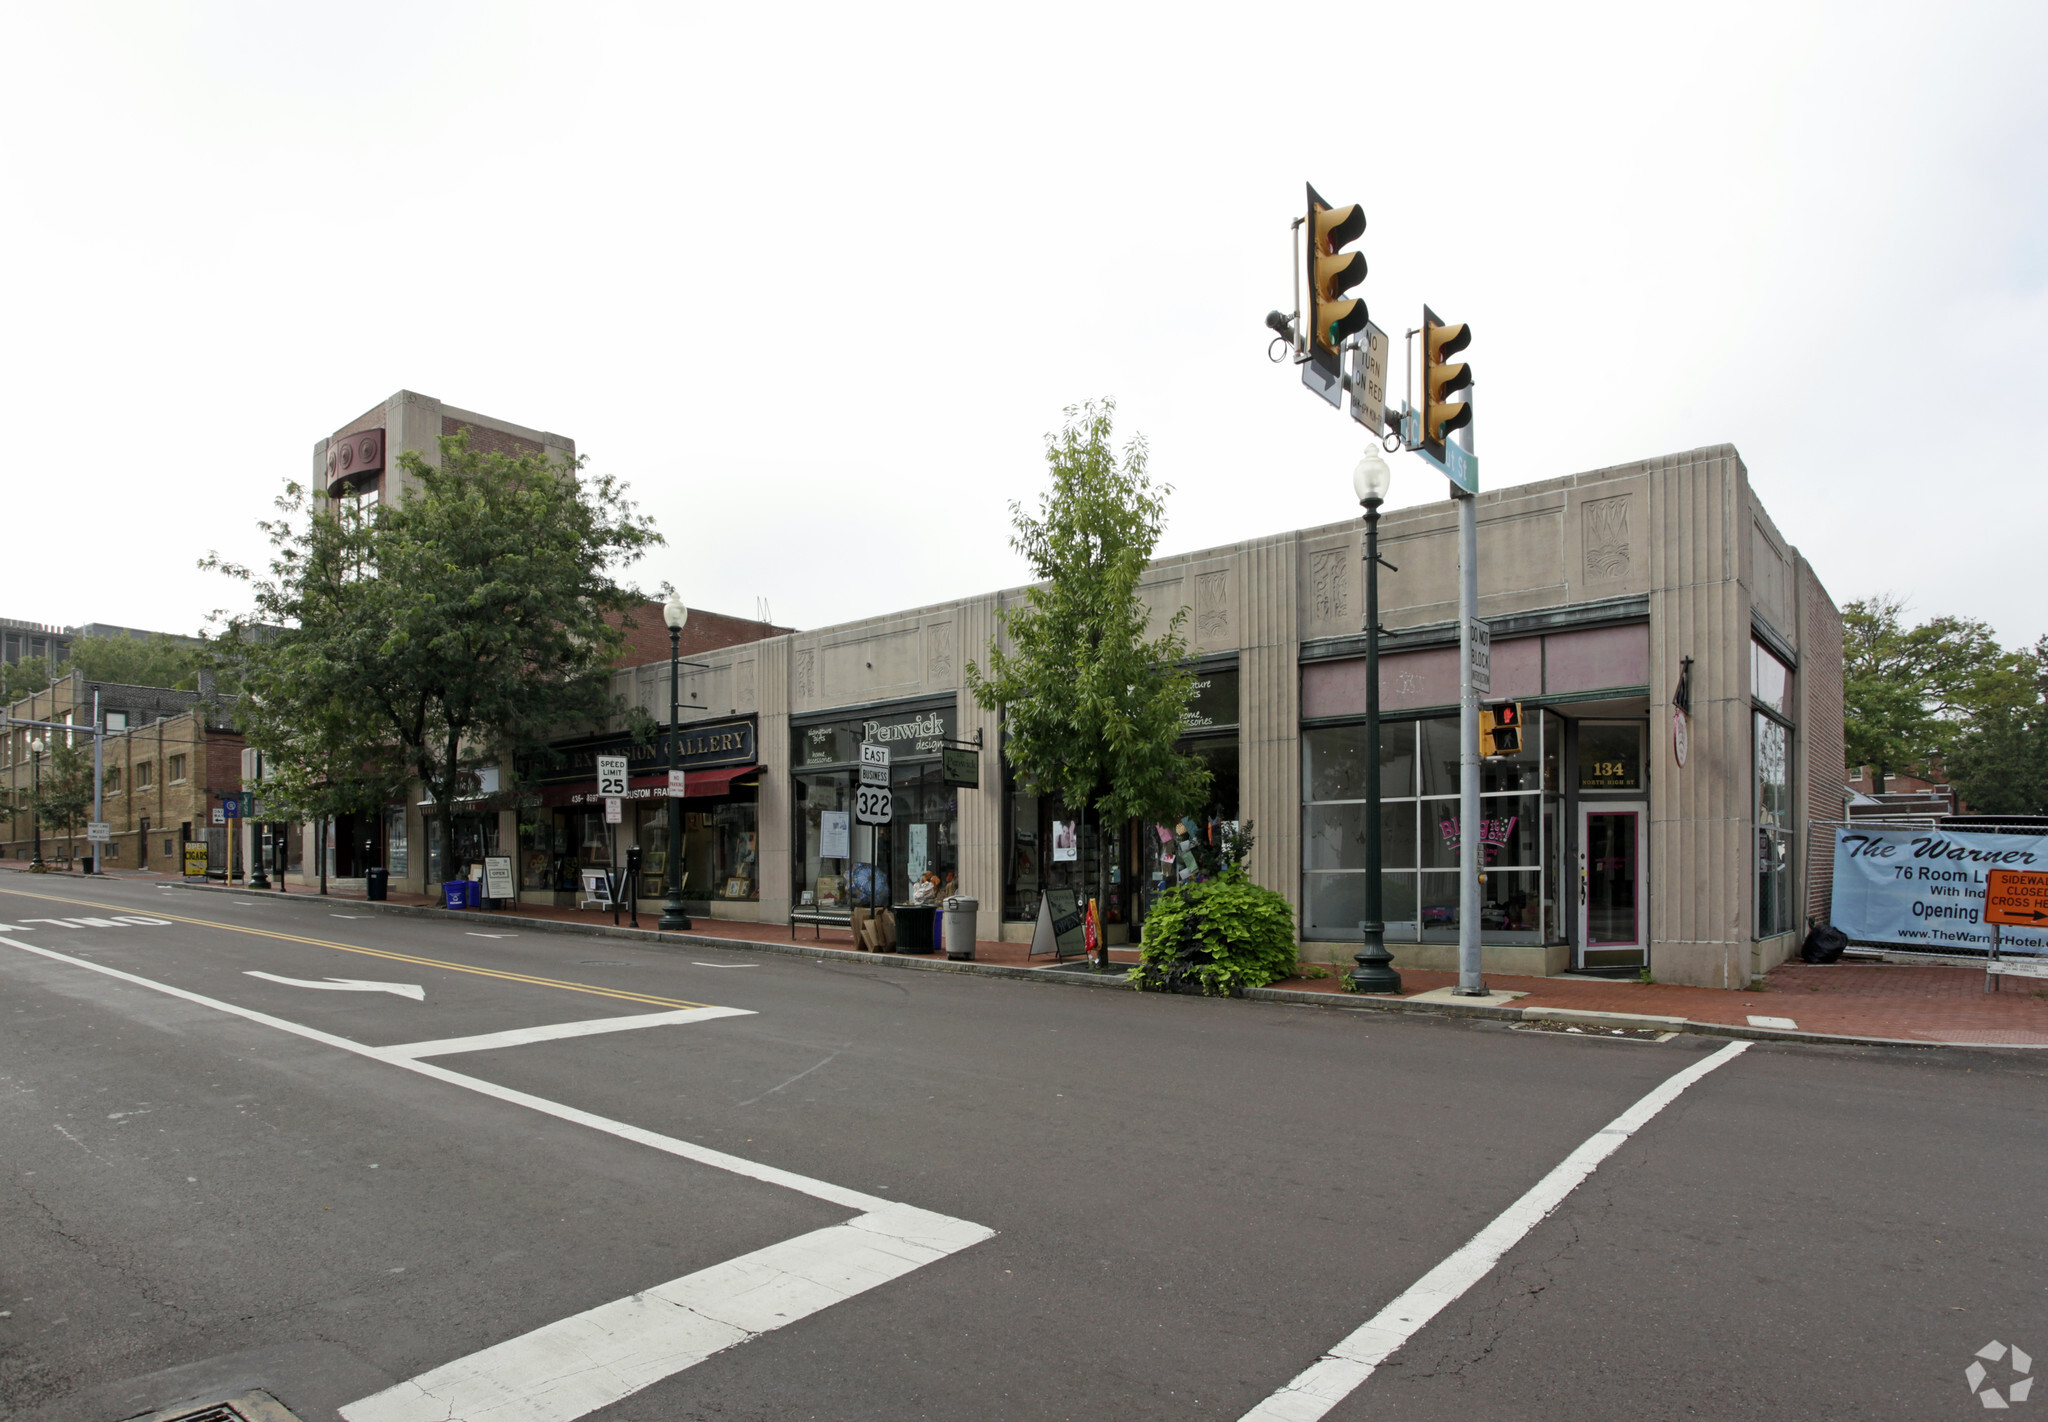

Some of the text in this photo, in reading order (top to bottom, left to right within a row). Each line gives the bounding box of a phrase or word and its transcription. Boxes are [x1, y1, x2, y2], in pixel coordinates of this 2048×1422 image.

[1366, 330, 1378, 351] NO
[1361, 352, 1381, 378] TURN
[1356, 370, 1382, 403] ON RED
[1458, 456, 1467, 480] St
[1471, 626, 1489, 647] DO NOT
[1471, 648, 1489, 669] BLOCK
[863, 712, 945, 743] Penwick
[664, 731, 746, 758] GALLERY
[916, 737, 944, 752] design
[600, 760, 625, 768] SPEED
[864, 747, 886, 763] EAST
[862, 769, 887, 782] BUSINESS
[1594, 762, 1624, 776] 134
[601, 778, 624, 794] 25
[626, 788, 651, 799] CUSTOM
[859, 792, 889, 816] 322
[1439, 817, 1490, 840] Blg
[185, 842, 207, 850] OPEN
[185, 851, 208, 860] CIGARS
[1841, 835, 2040, 865] The Warner
[1894, 866, 1913, 880] 76
[1918, 867, 1968, 882] Room
[1930, 885, 1986, 899] With Ind
[1991, 896, 2030, 907] CROSS
[1912, 901, 1979, 924] Opening
[1898, 929, 2048, 948] www.TheWarnrHotel.
